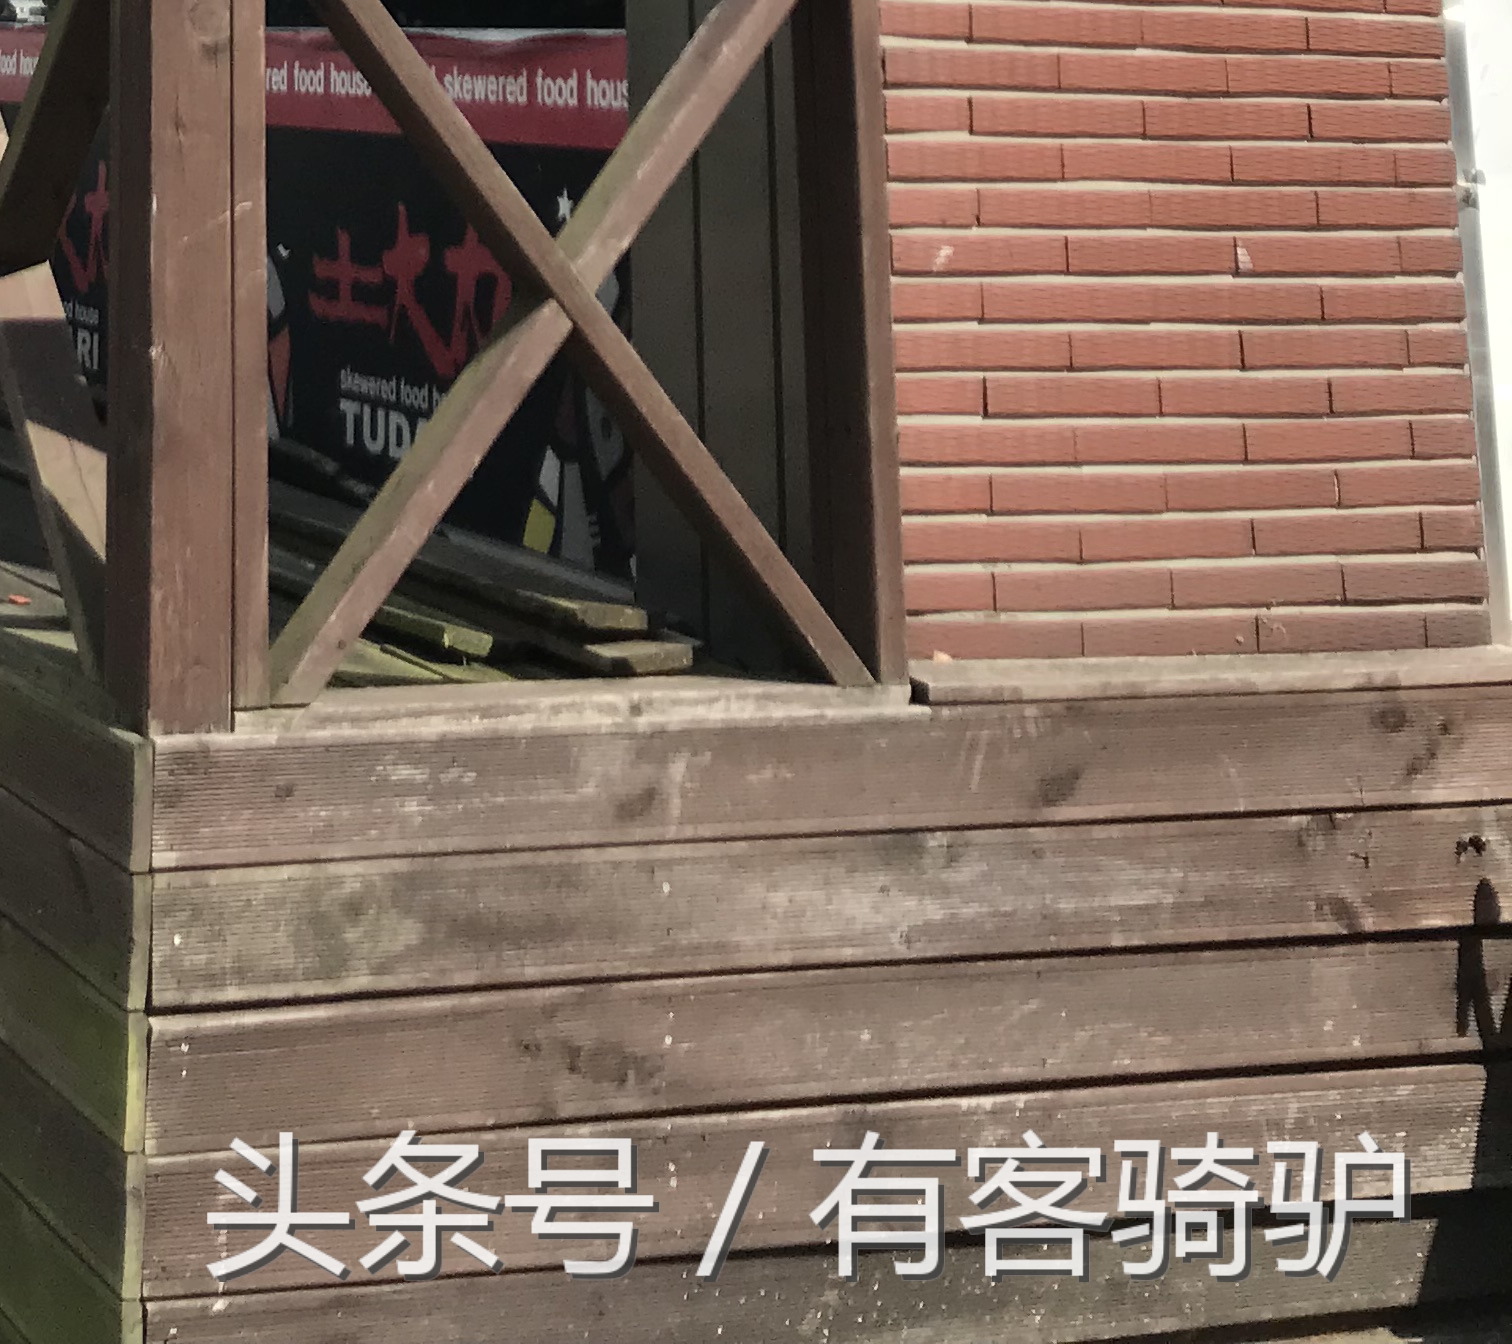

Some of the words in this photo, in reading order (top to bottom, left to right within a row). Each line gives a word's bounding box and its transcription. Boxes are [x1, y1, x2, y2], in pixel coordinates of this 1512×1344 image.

[294, 60, 324, 93] food
[443, 66, 527, 105] skewered
[536, 68, 578, 107] food
